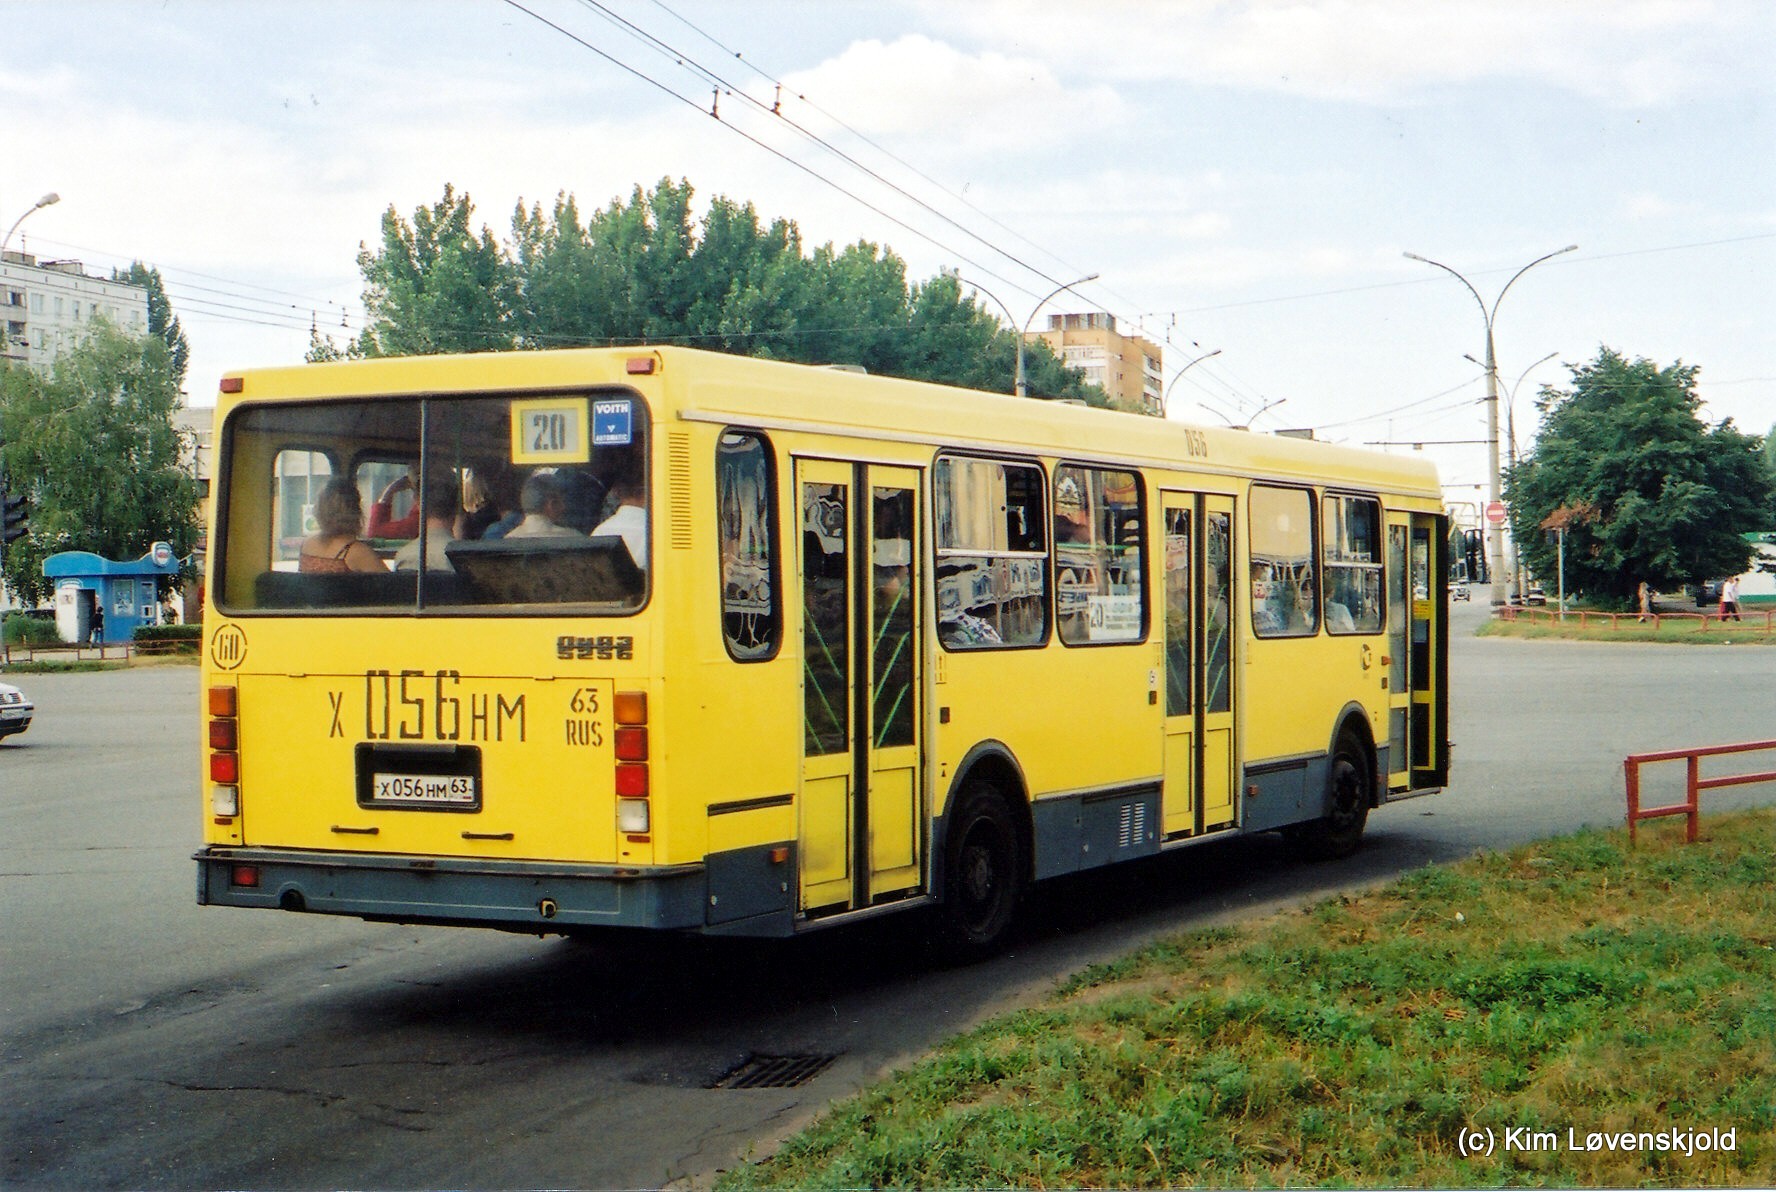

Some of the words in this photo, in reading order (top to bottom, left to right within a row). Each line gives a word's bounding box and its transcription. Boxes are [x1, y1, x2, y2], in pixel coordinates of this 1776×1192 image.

[596, 403, 629, 414] VOITH
[533, 413, 565, 450] 20
[596, 433, 628, 441] AUTOMATIC
[1184, 428, 1208, 458] 056
[1090, 602, 1103, 628] 20
[570, 688, 599, 714] 63
[566, 719, 603, 747] RUS
